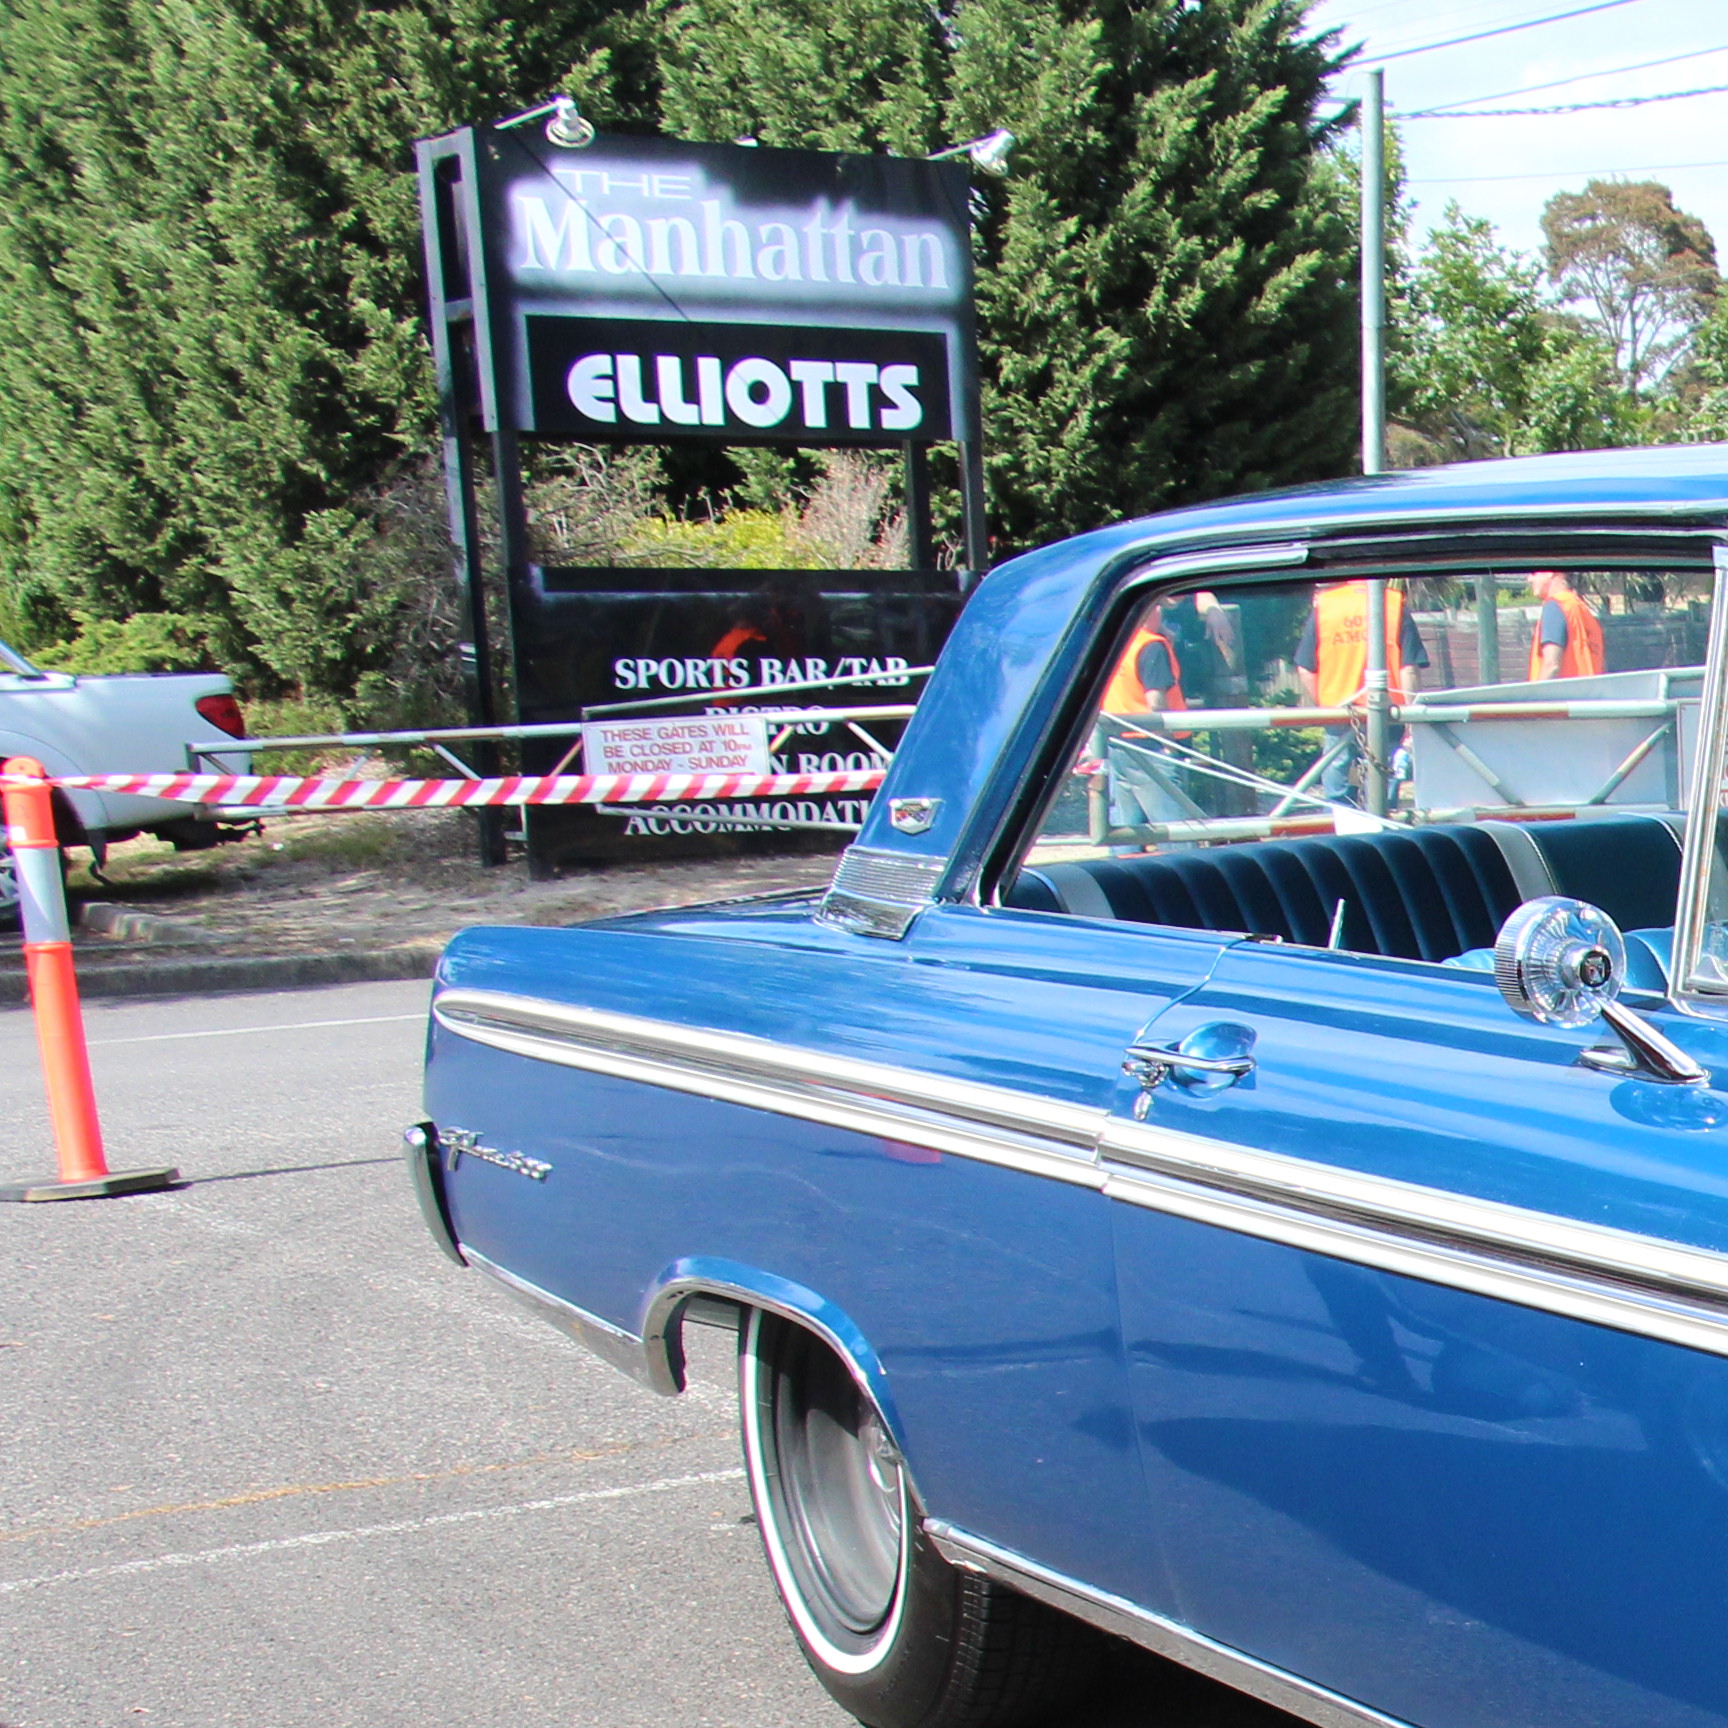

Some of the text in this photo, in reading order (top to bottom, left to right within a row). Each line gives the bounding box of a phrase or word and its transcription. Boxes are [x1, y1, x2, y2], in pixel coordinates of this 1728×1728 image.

[552, 167, 693, 201] THE
[518, 194, 949, 290] Manhattan
[566, 352, 923, 430] ELLIOTTS
[613, 656, 911, 690] SPORTS BAR/TAB
[600, 723, 750, 743] THESE GATES WILL
[603, 745, 625, 759] BE
[629, 741, 693, 758] CLOSED
[697, 740, 718, 753] AT
[607, 758, 674, 775] MONDAY
[687, 754, 749, 771] SUNDAY
[624, 799, 869, 837] ACCOMMODATI
